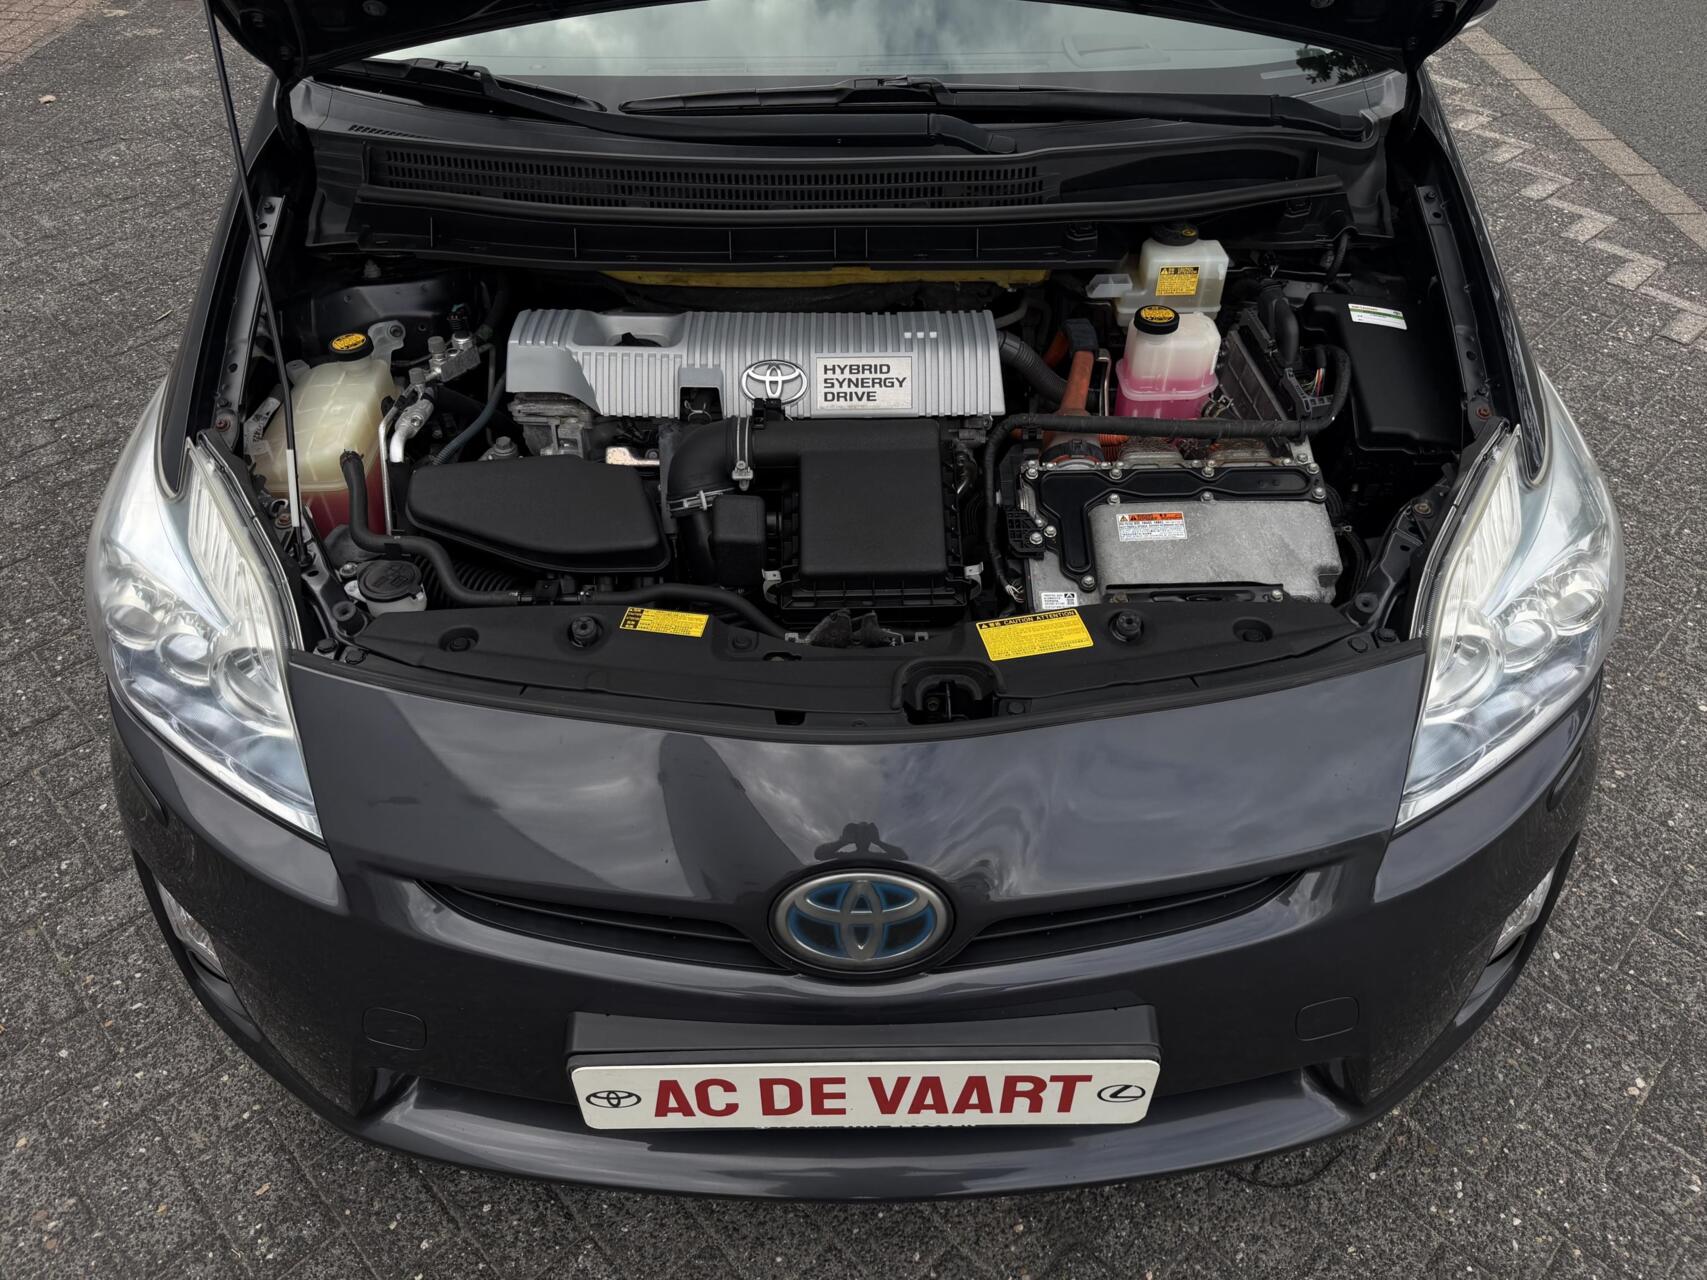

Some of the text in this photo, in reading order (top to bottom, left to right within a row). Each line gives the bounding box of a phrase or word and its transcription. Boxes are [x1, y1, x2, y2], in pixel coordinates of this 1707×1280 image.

[824, 364, 890, 374] HYBRID
[824, 377, 907, 388] SYNERGY
[824, 391, 877, 402] DRIVE
[1003, 617, 1034, 626] CAUTION
[1036, 611, 1075, 621] ATTENTION
[656, 1075, 1092, 1117] AC DE VAART
